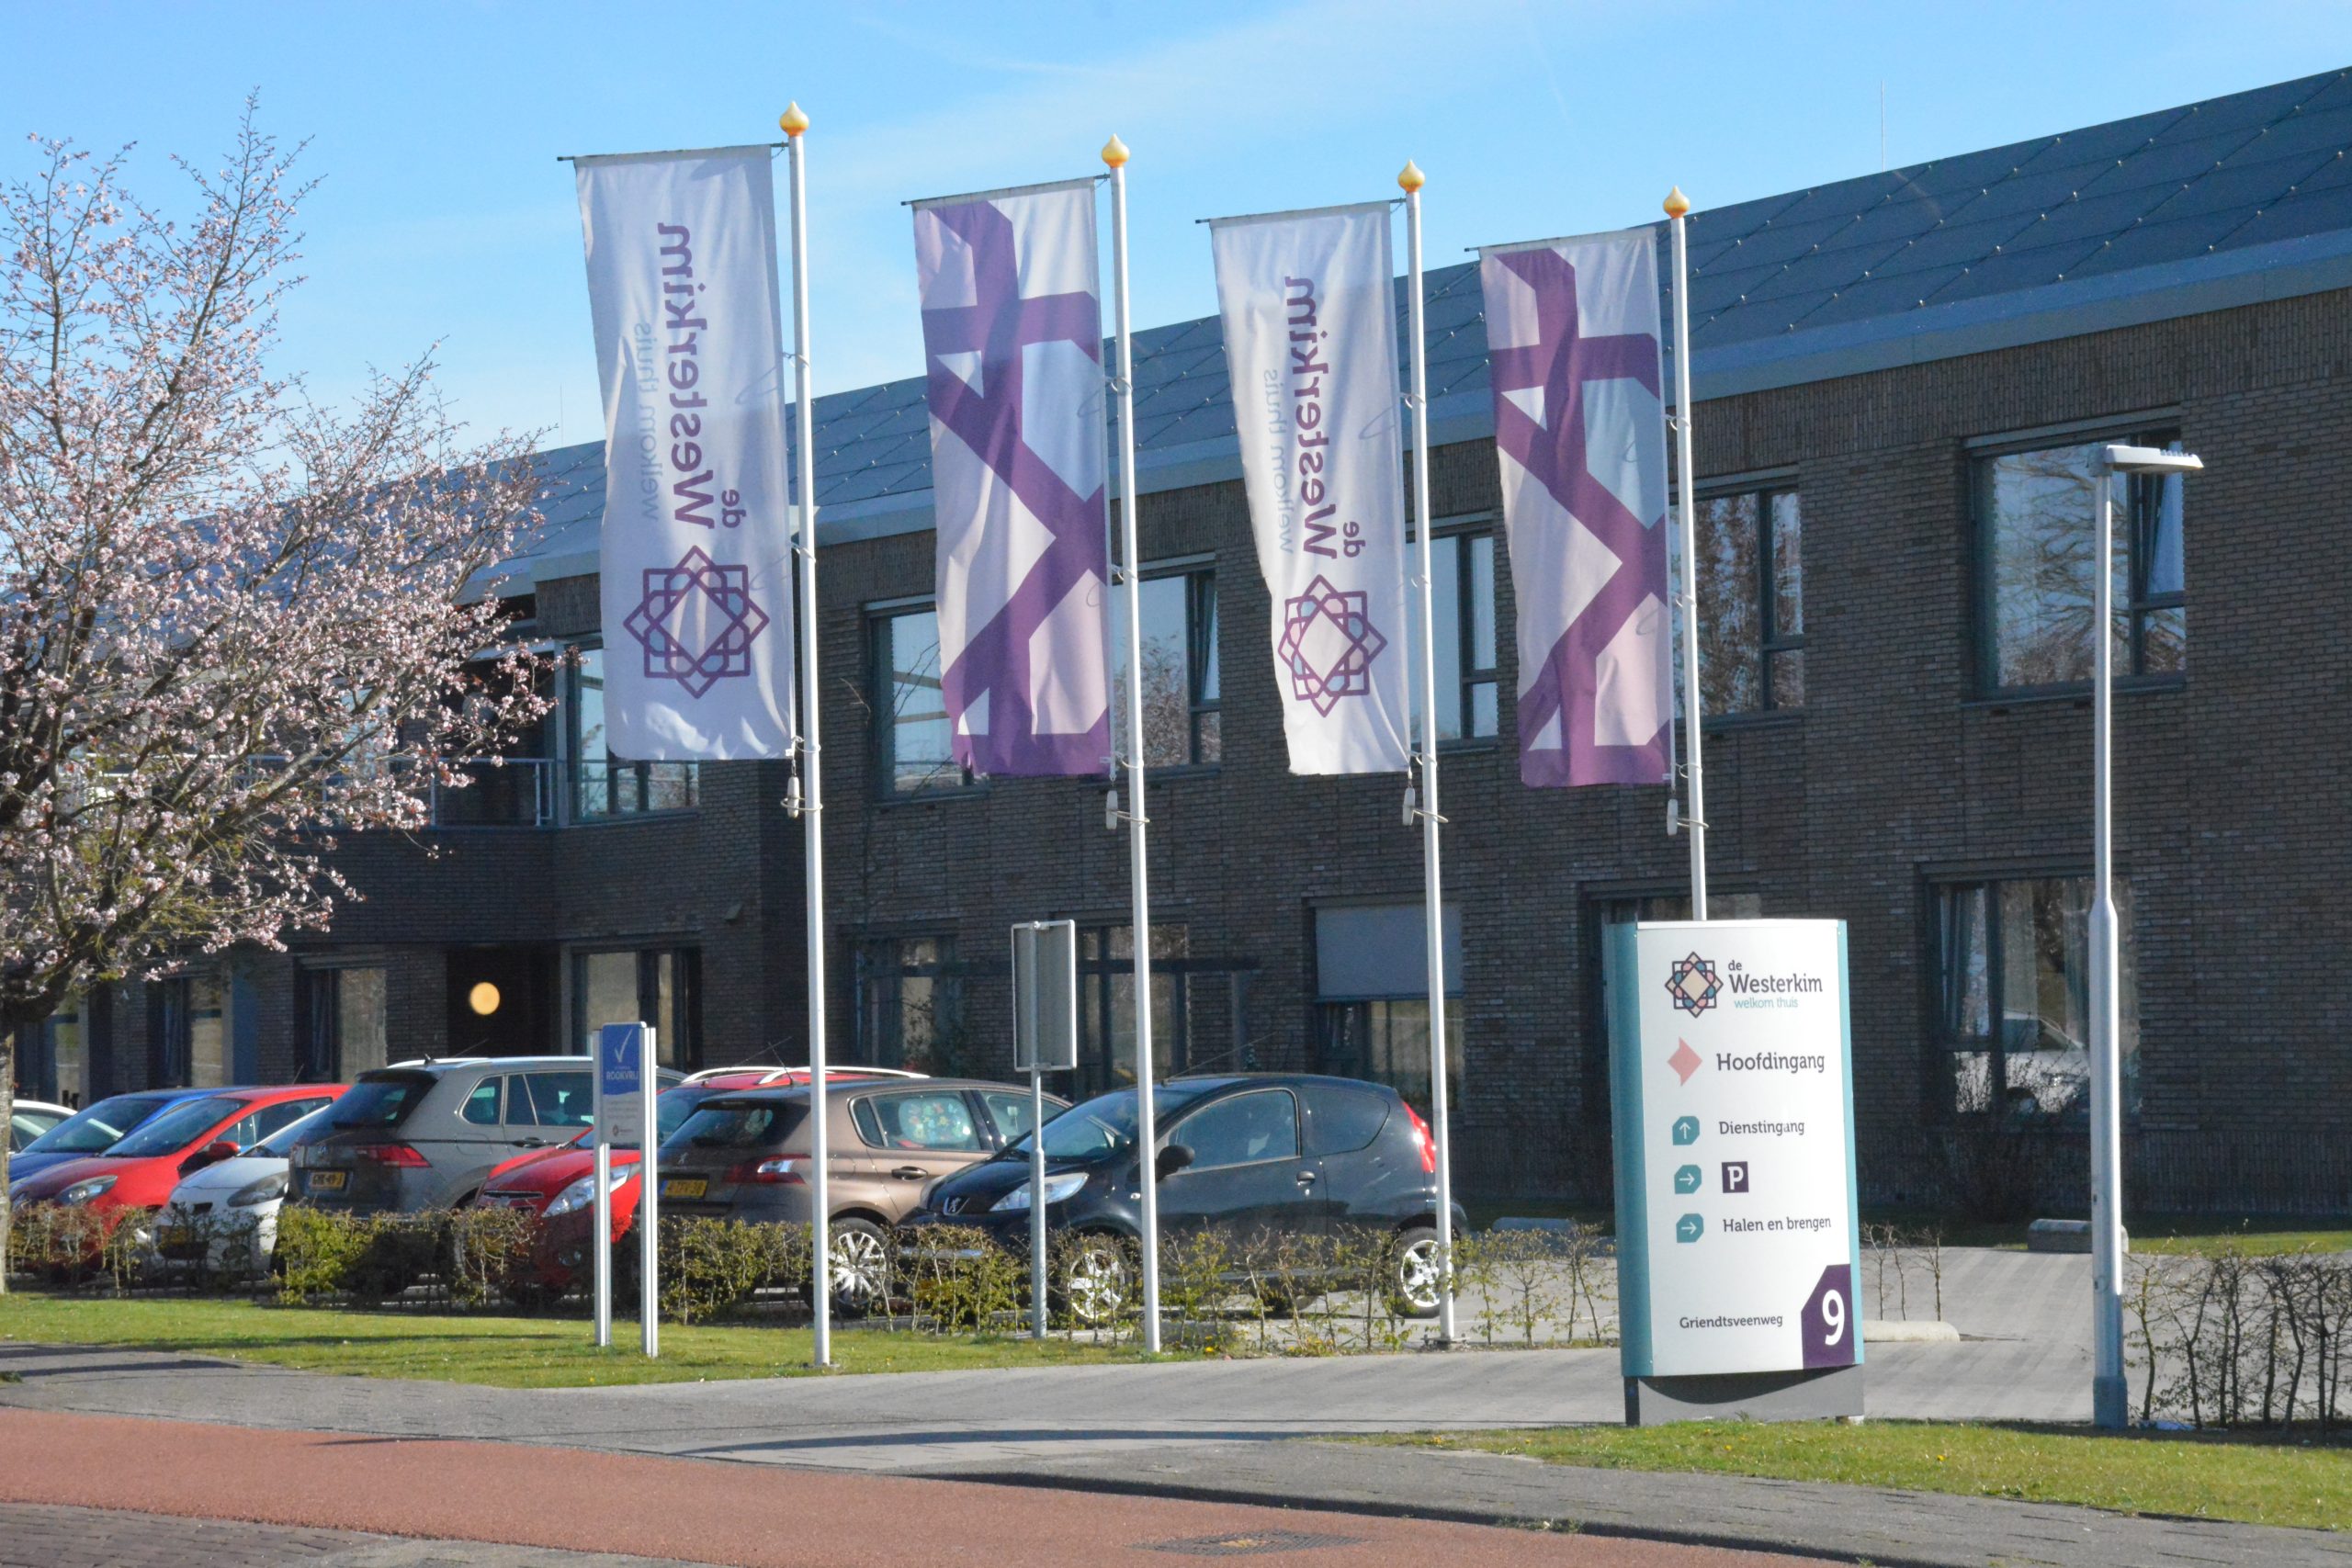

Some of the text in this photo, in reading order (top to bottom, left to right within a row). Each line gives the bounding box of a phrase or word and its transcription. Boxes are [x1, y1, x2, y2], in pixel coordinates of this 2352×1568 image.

[1728, 959, 1742, 971] de
[1729, 973, 1823, 994] Westerkim
[1734, 997, 1798, 1009] welkom thuis
[1716, 1052, 1825, 1073] Hoofdingang
[1719, 1121, 1804, 1135] Dienstingang
[1727, 1166, 1744, 1190] P
[1723, 1216, 1831, 1232] Halen en brengen
[1679, 1314, 1783, 1329] Griendtsveenweg
[1822, 1289, 1845, 1346] 9
